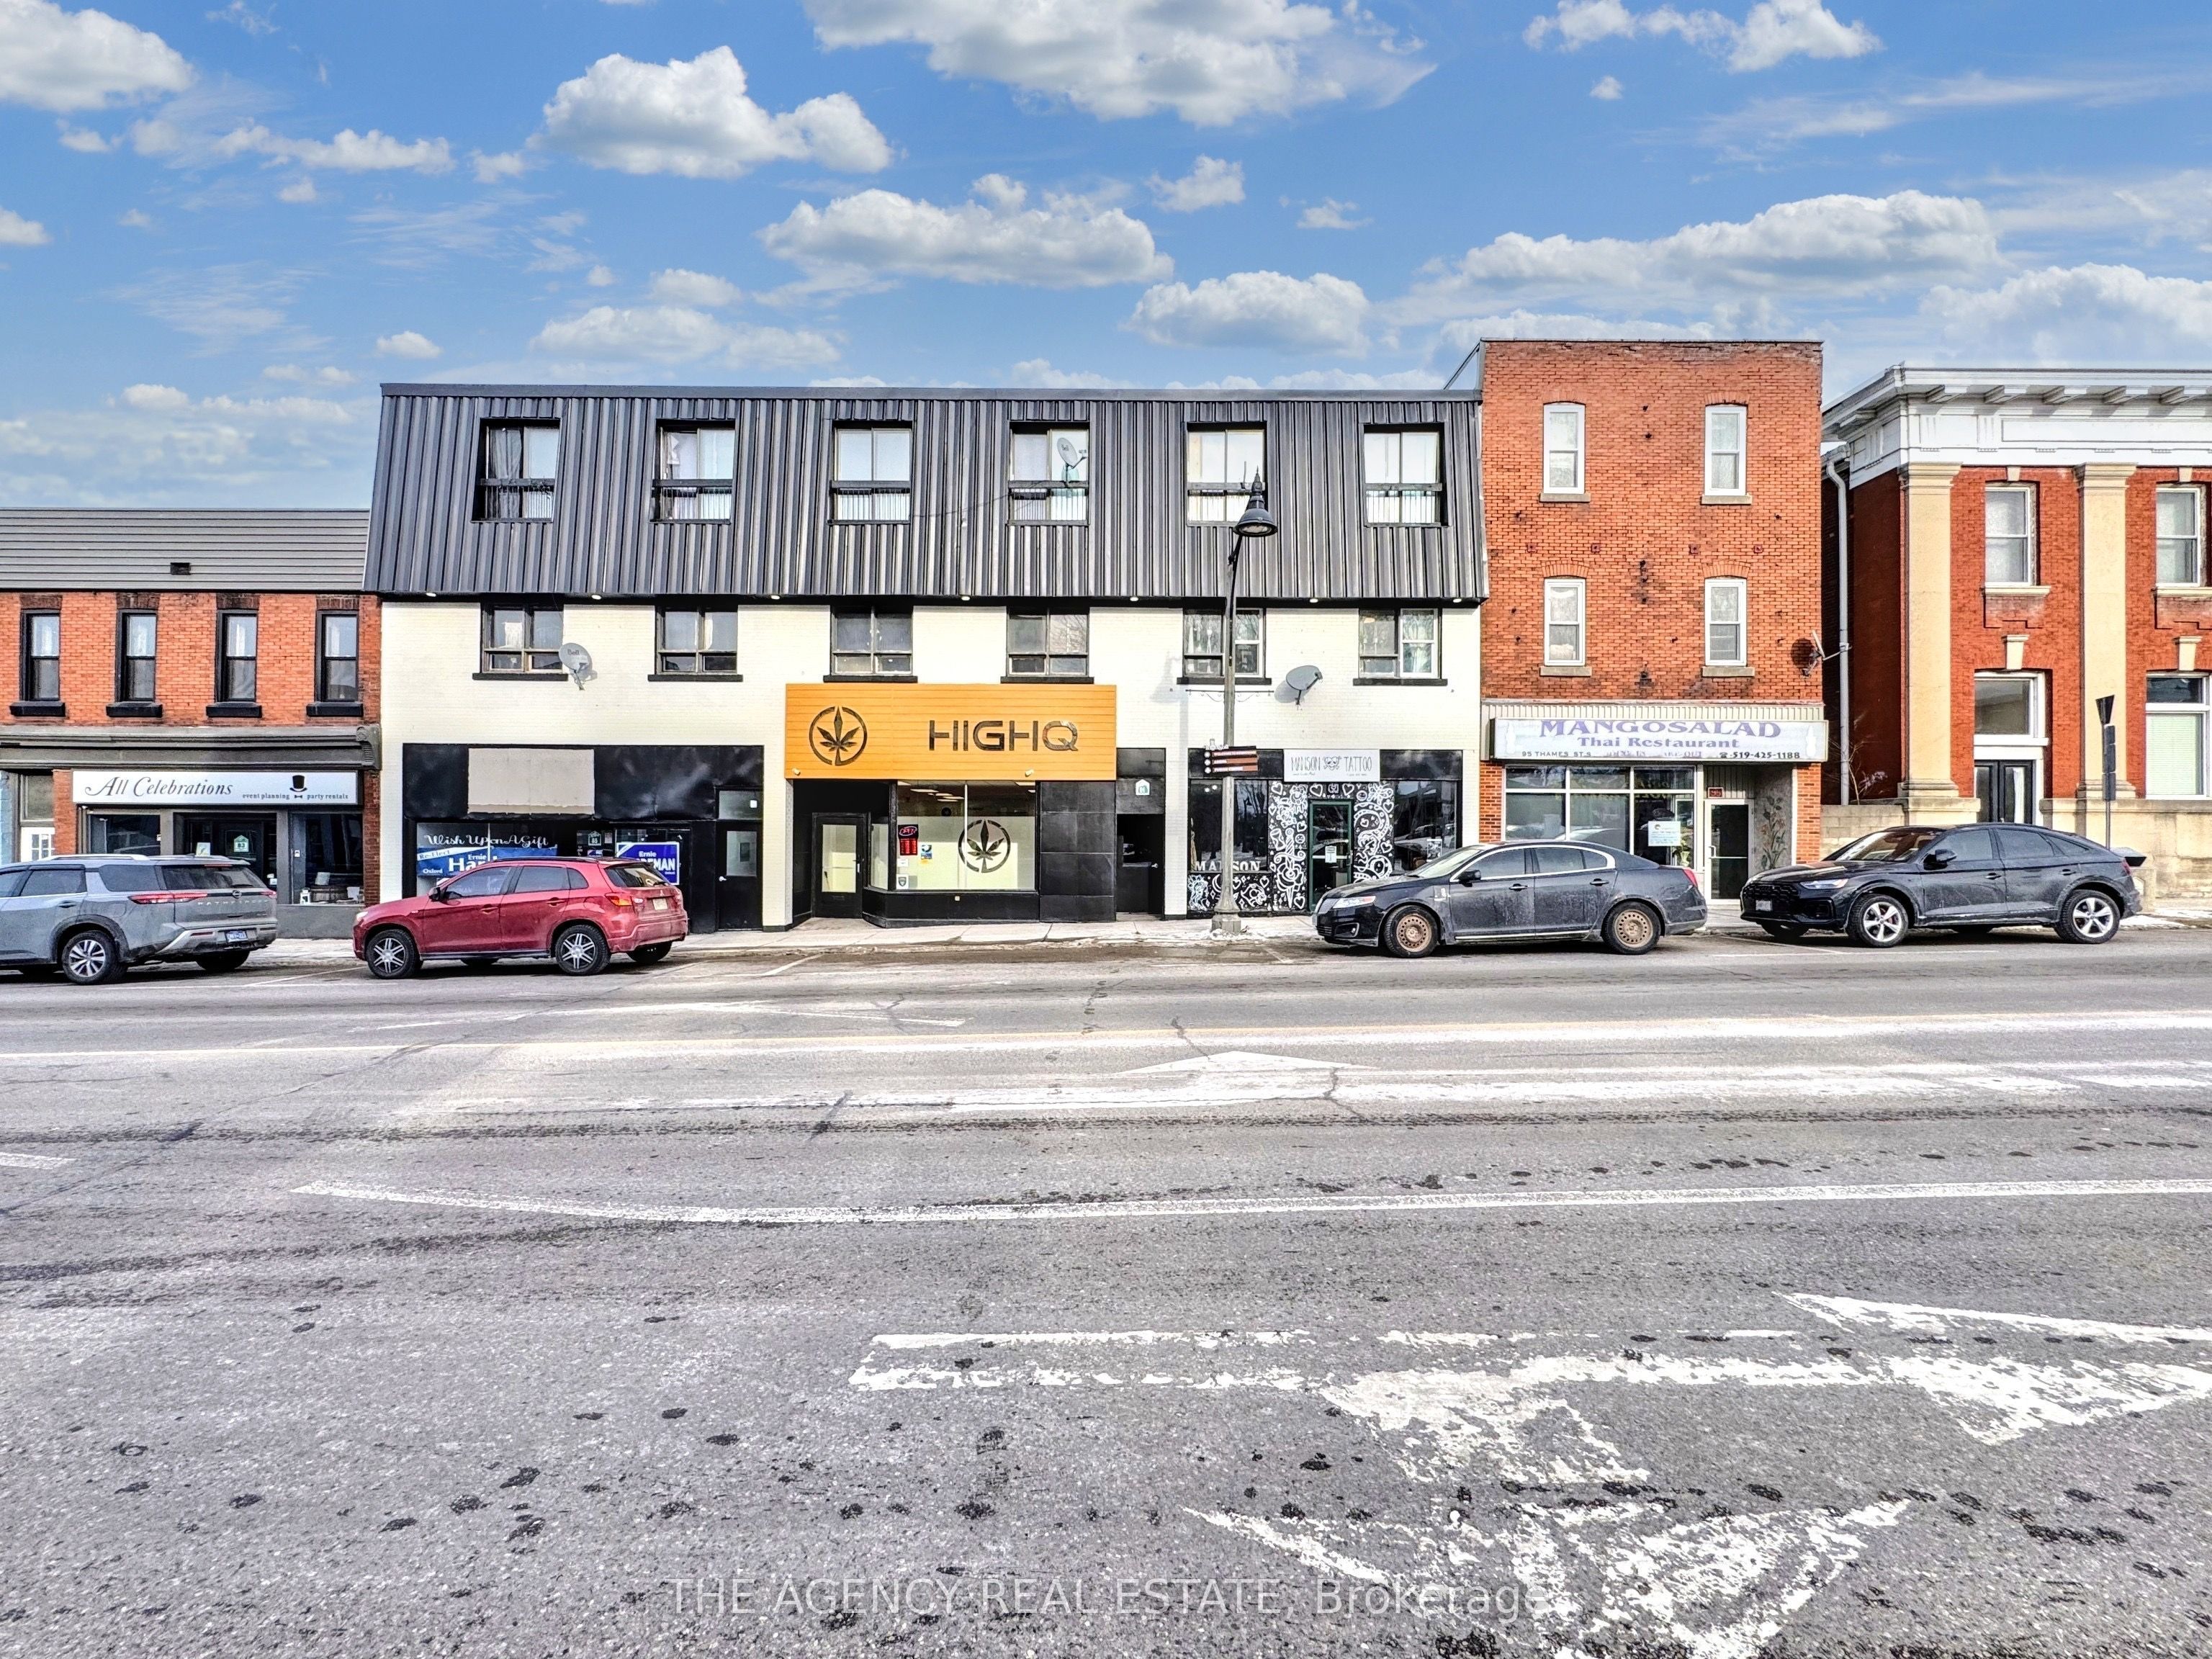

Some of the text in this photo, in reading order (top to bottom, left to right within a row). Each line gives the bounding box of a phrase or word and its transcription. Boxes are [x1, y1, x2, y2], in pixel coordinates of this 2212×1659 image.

[929, 720, 1078, 751] HIGHQ
[1539, 720, 1781, 738] MANGOSALAD
[1577, 737, 1739, 748] Thai Restaurant
[1291, 756, 1372, 772] MANSON TATTOO
[84, 776, 233, 796] All Celebrations
[423, 835, 465, 845] Wish
[505, 835, 518, 845] A
[518, 835, 549, 849] Gift
